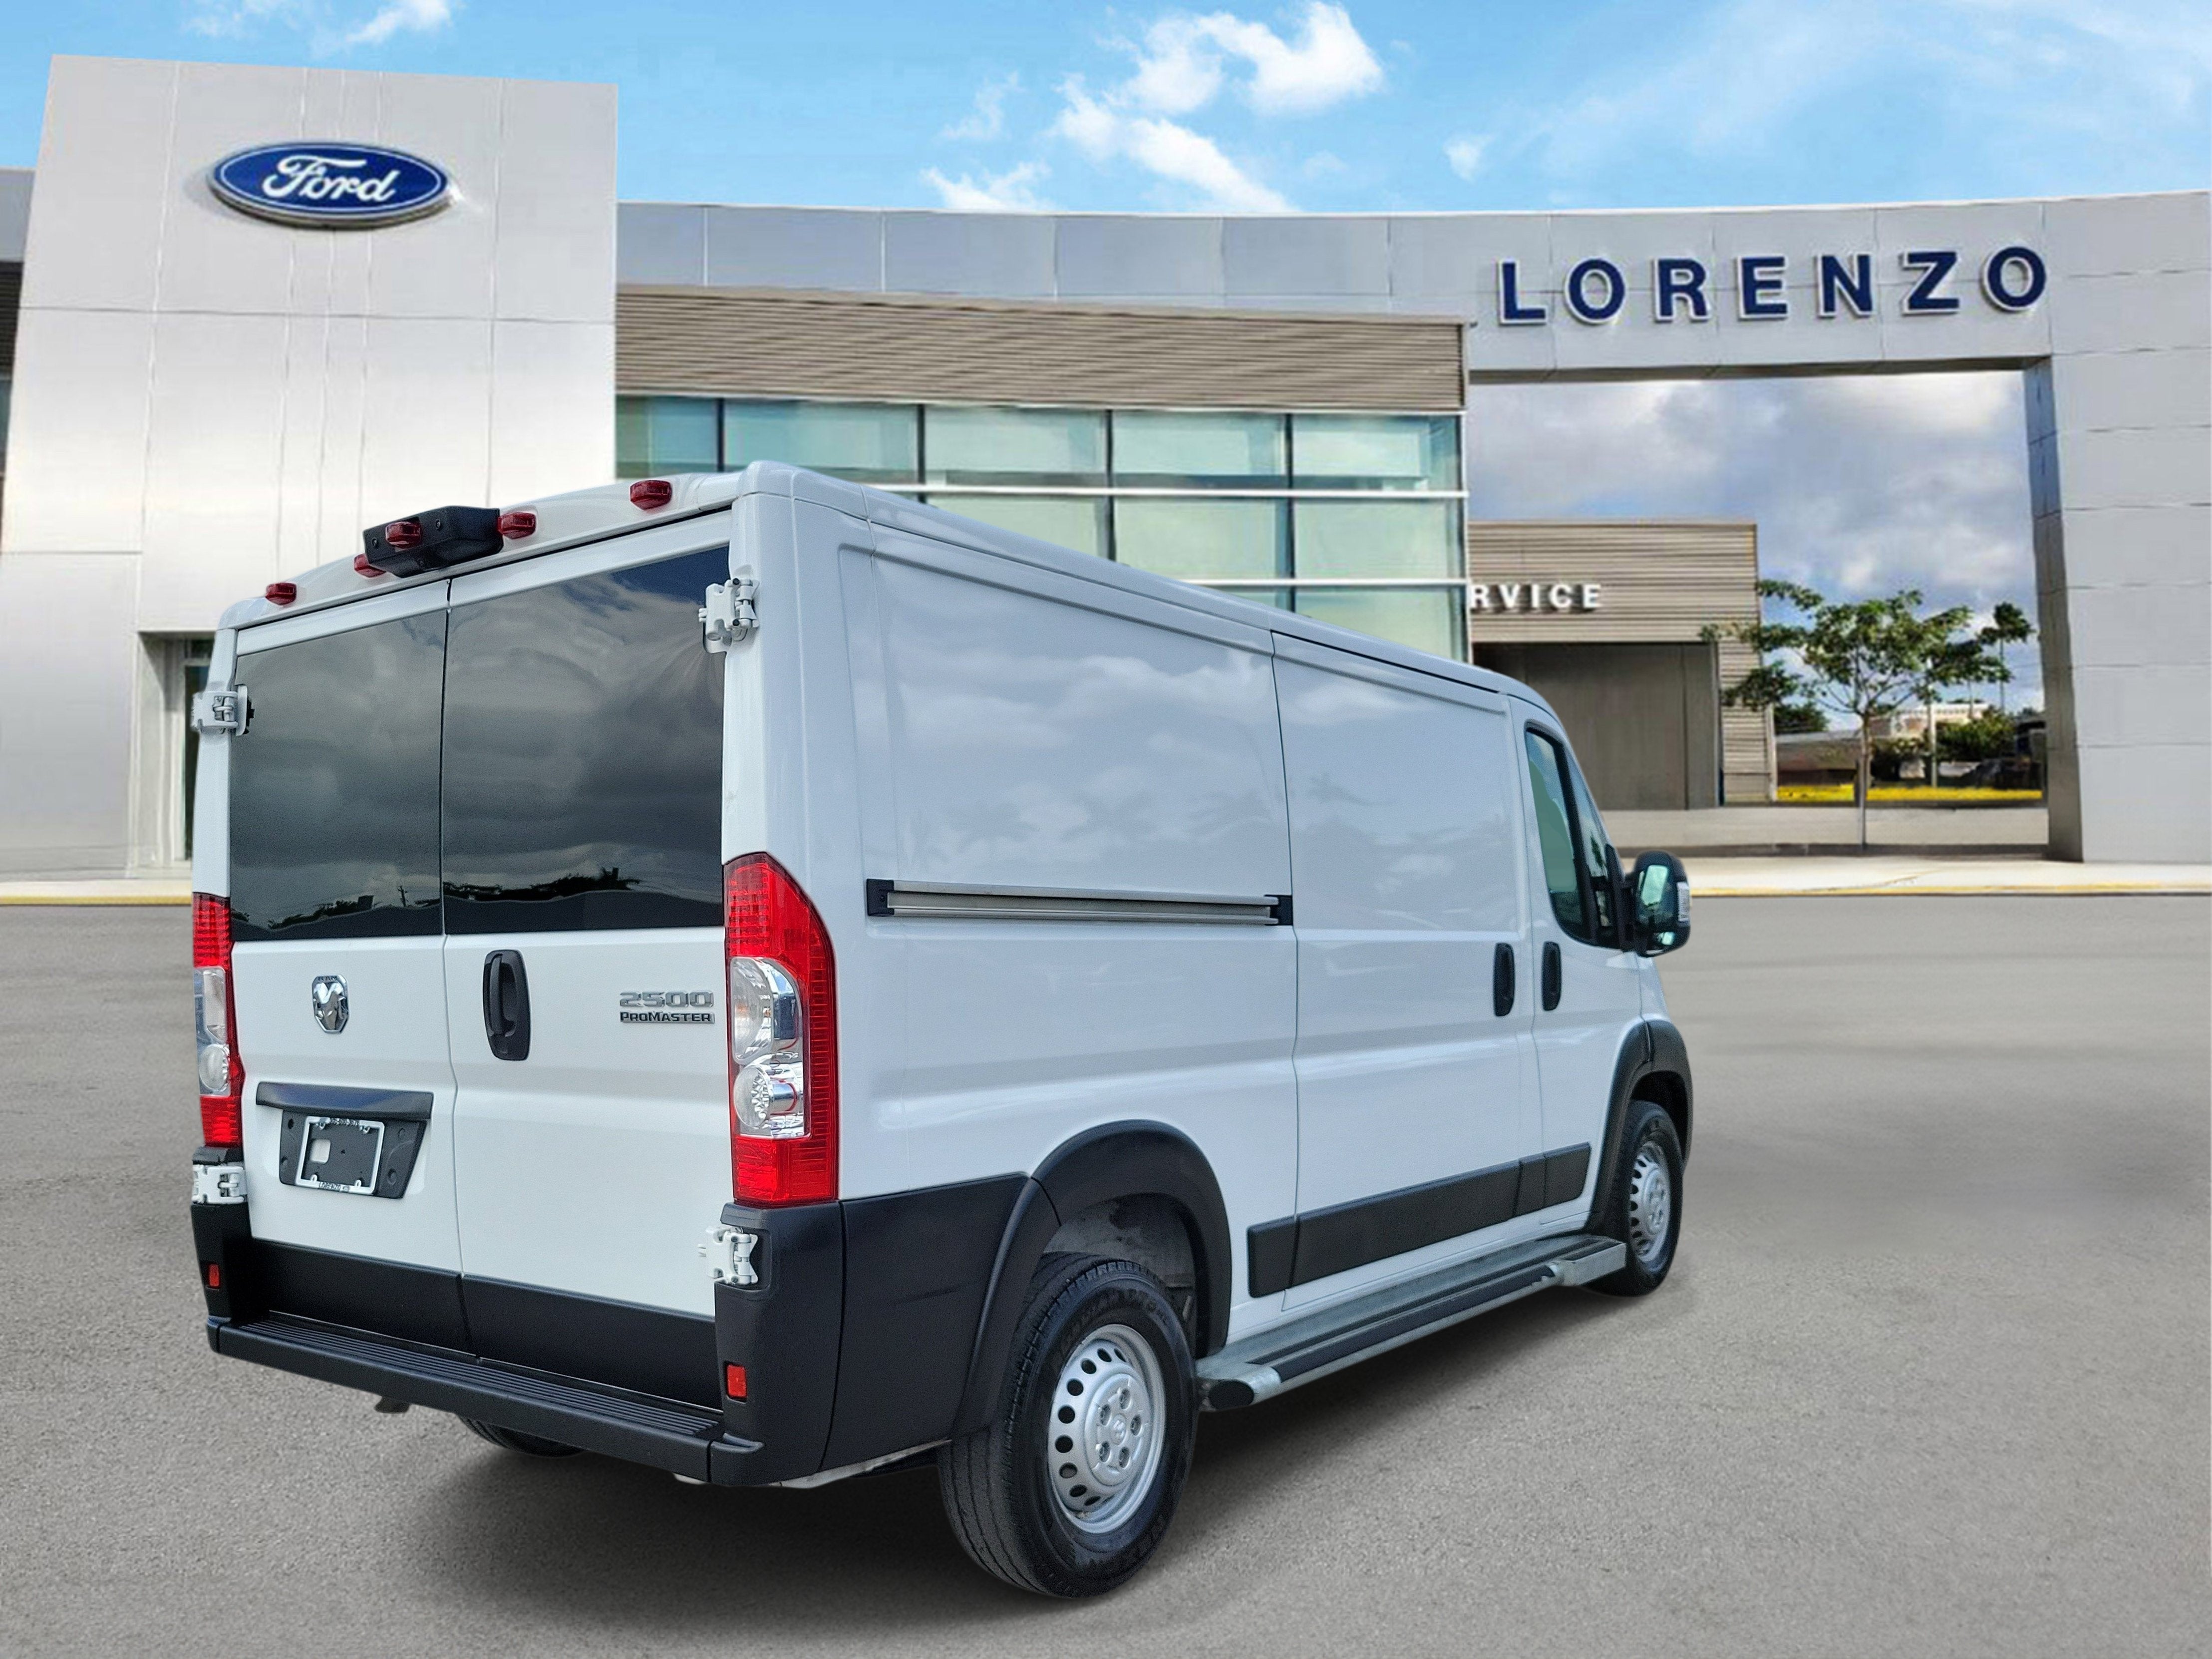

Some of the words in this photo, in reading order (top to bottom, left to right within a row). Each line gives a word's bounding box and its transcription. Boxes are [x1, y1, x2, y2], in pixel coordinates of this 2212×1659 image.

[262, 154, 400, 202] Ford
[1500, 246, 2047, 323] LORENZO
[620, 992, 714, 1007] 2500
